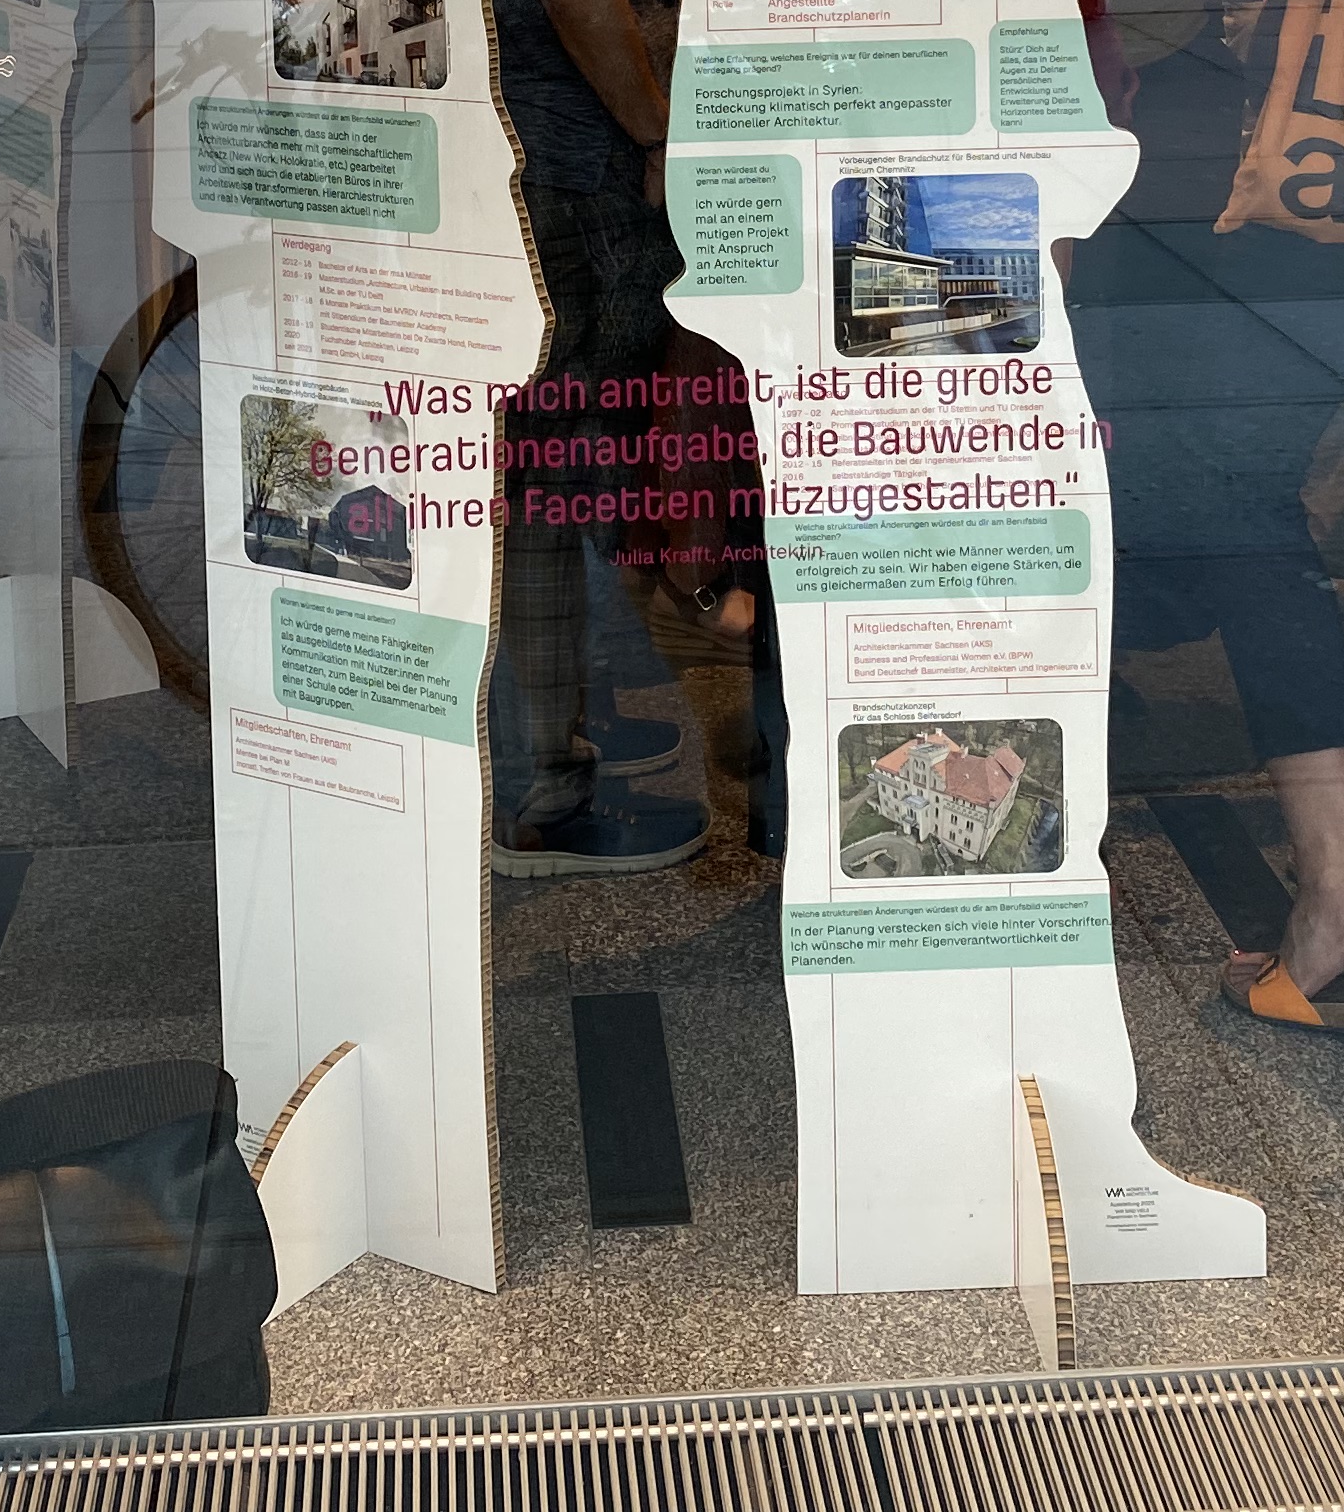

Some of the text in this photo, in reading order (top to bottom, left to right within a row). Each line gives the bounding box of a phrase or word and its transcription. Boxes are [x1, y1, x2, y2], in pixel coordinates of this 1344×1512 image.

[768, 9, 890, 24] Brandschutzplanerin
[695, 83, 862, 100] Forschungsprojekt Syrien:
[695, 96, 952, 116] Entdeckung klimatisch perfekt angepasster
[306, 201, 338, 213] passen
[340, 204, 371, 218] aktuell
[373, 207, 395, 219] nicht
[281, 238, 332, 254] Werdegang
[366, 359, 1054, 426] „Was mich antreibt, ist die große
[309, 409, 1113, 480] Generationenaufgabe, die Bauwende in
[347, 472, 1081, 538] all ihren Facetten mitzugestalten.“
[609, 540, 823, 567] Julia Krafft, Architektin
[820, 573, 1017, 591] gleichermaßen Erfolg führen.
[853, 618, 1013, 634] Mitgliedschaften, Ehrenamt
[853, 702, 936, 713] Brandschutzkonzept
[827, 915, 1112, 936] Planung verstecken hinter Vorschriften.
[921, 932, 1057, 948] Eigenverantwortlichkeit
